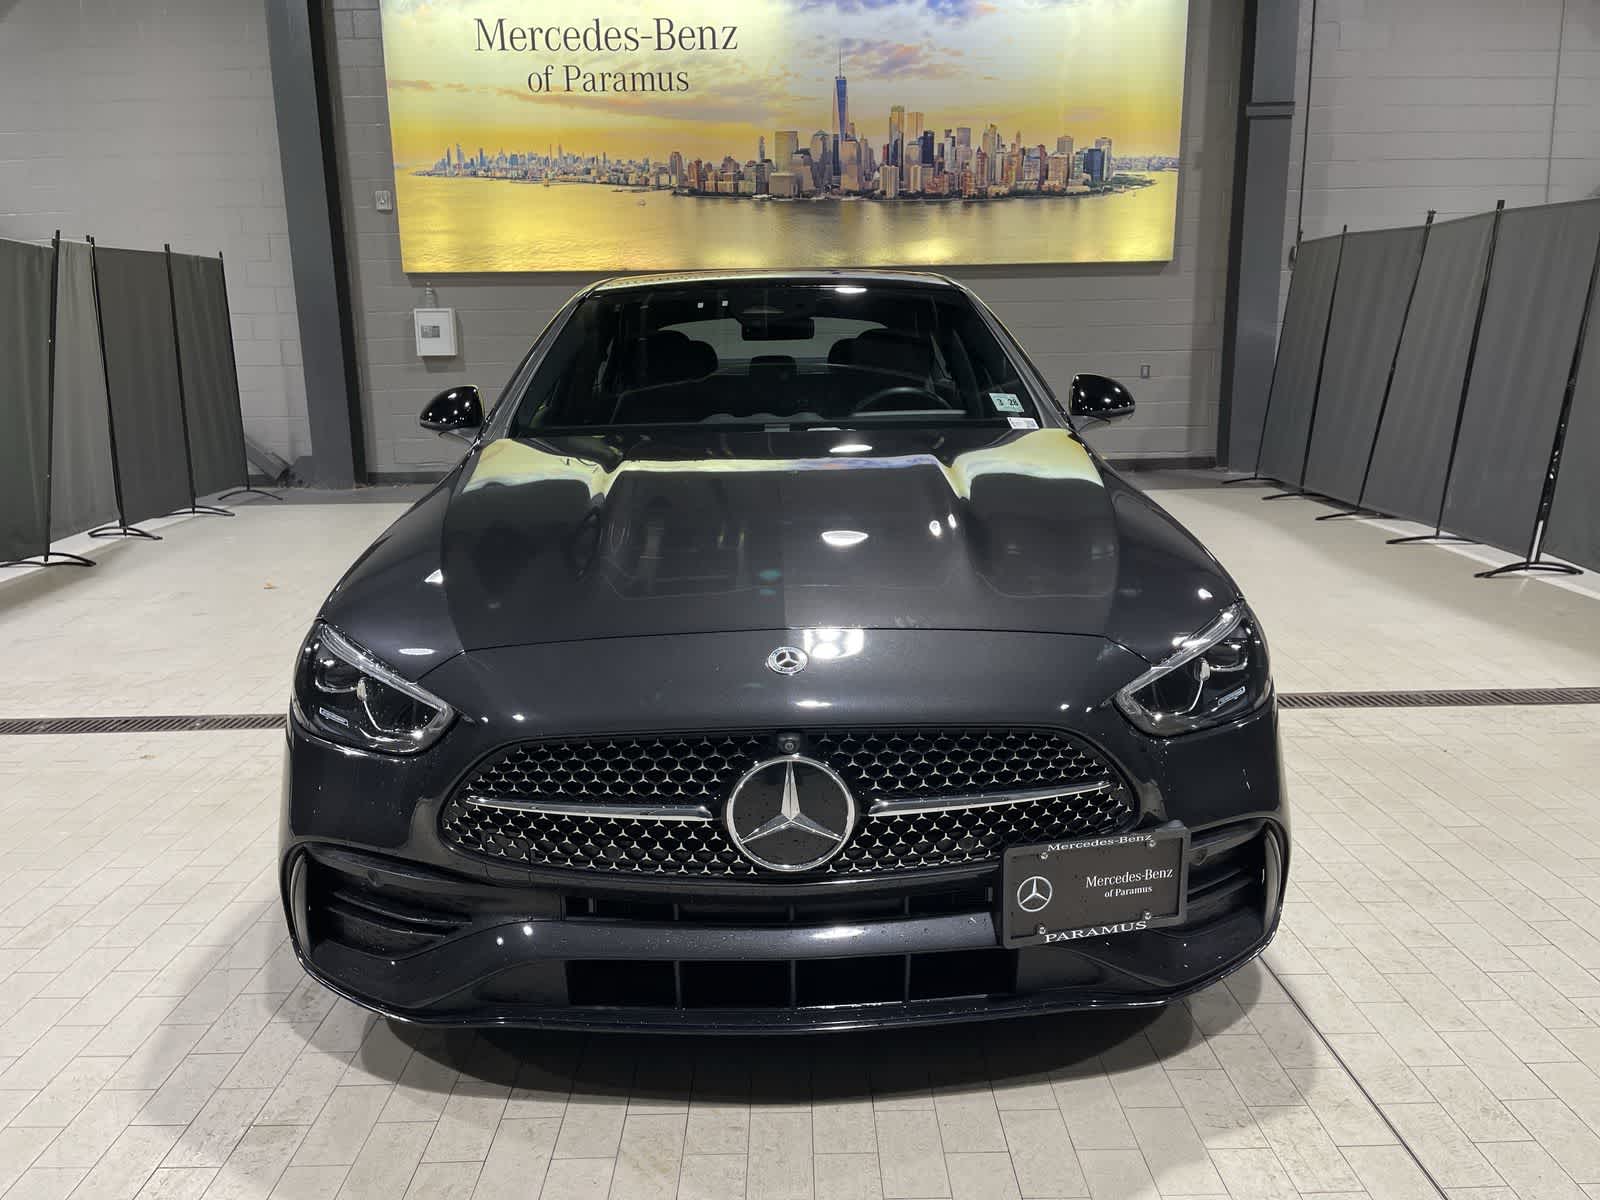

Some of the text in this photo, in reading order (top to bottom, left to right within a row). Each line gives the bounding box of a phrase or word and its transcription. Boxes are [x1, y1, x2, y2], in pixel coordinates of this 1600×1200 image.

[474, 17, 738, 52] Mercedes-Benz
[527, 65, 689, 92] of Paramus
[1047, 834, 1153, 852] Mercedes-Benz
[1085, 868, 1173, 889] Mercedes-Benz
[1104, 885, 1153, 898] of Paramus
[1044, 920, 1148, 944] PARAMUS
